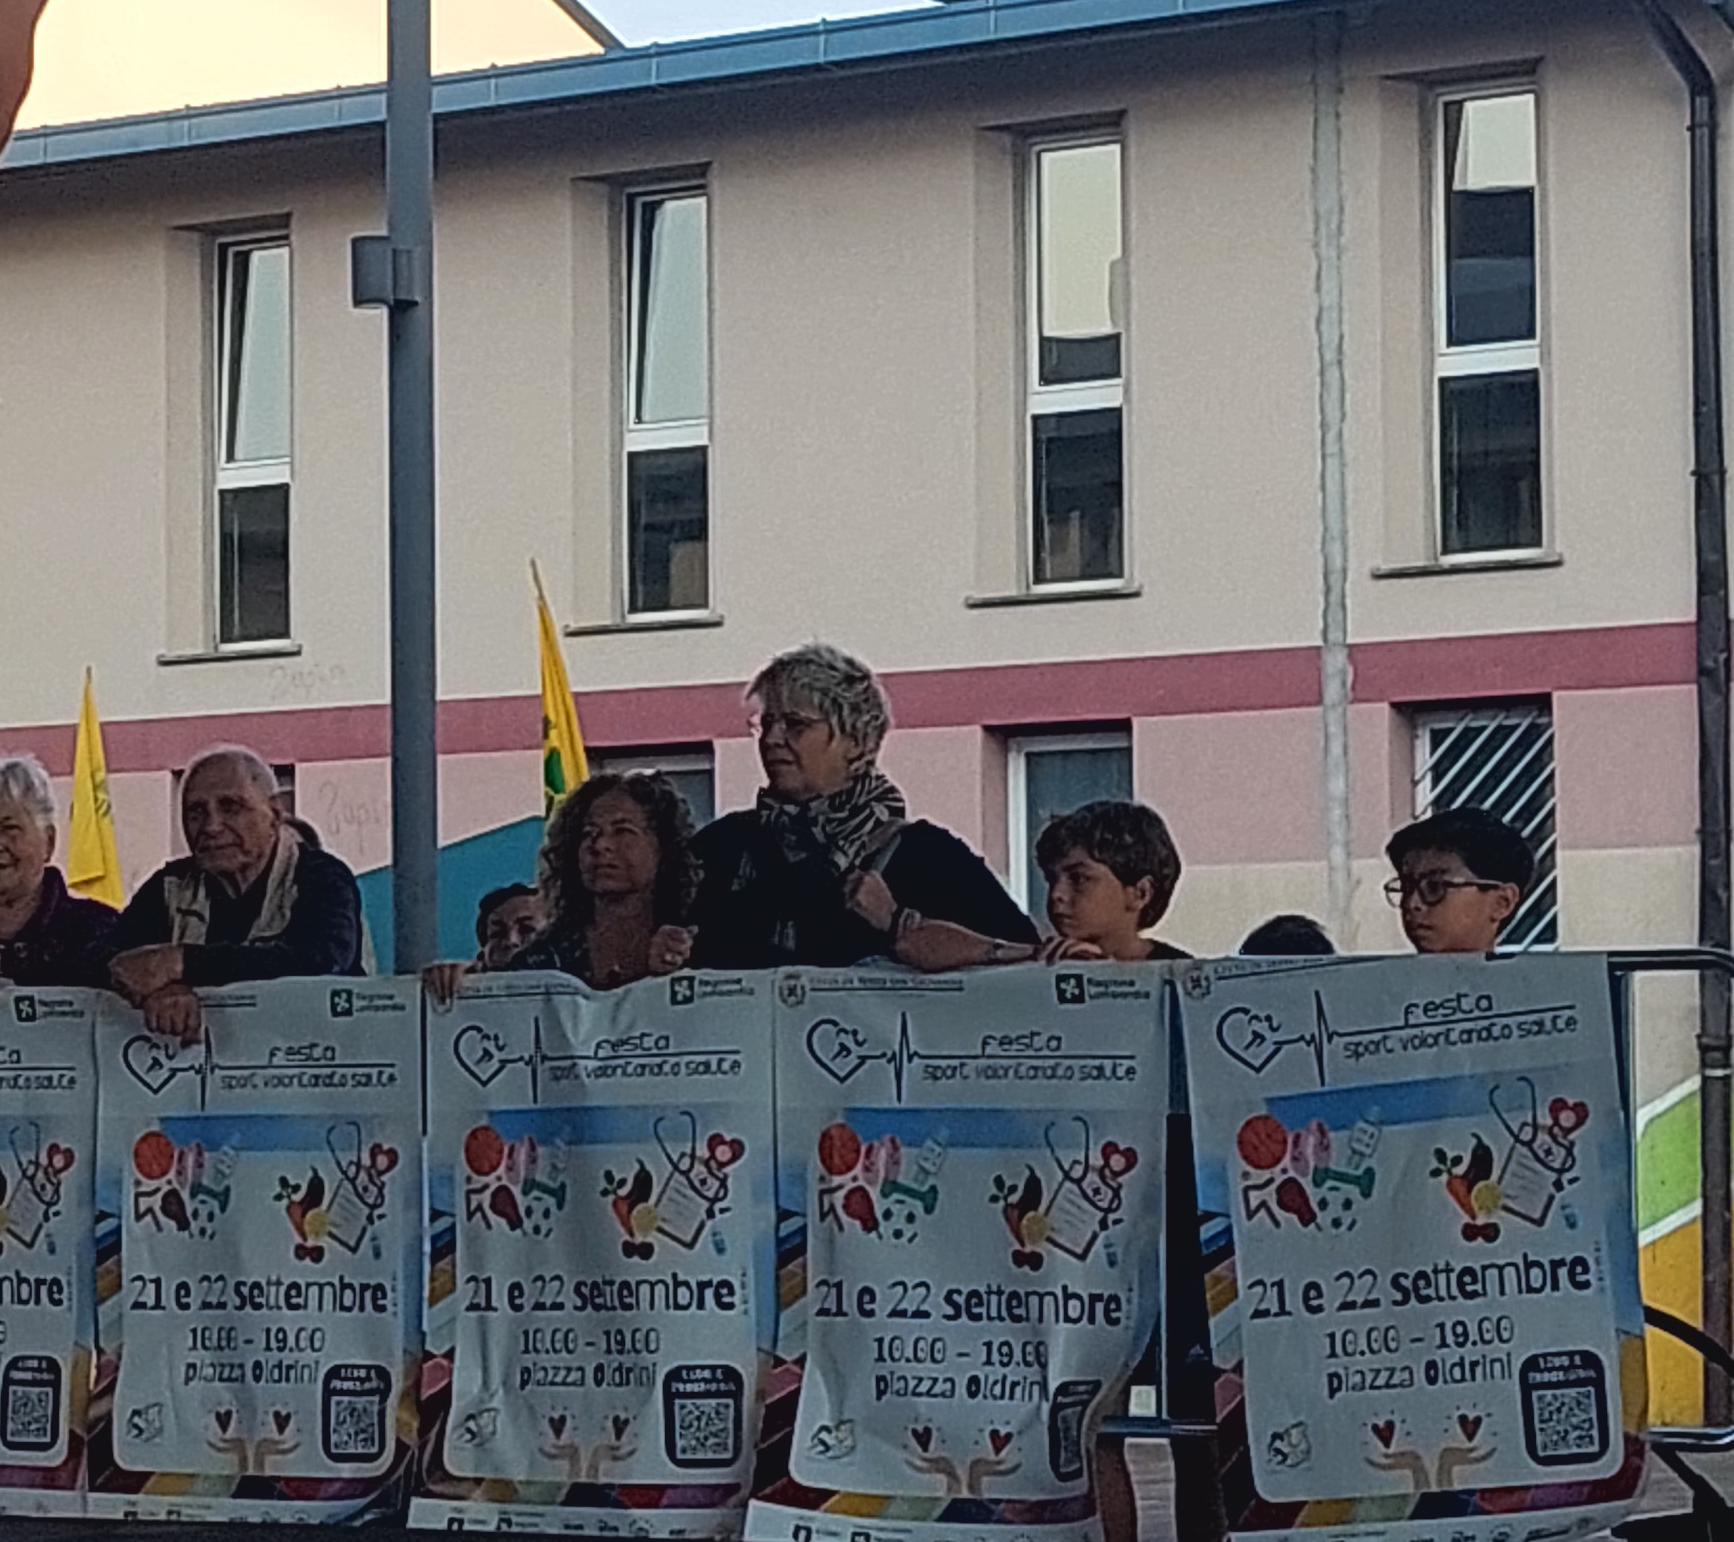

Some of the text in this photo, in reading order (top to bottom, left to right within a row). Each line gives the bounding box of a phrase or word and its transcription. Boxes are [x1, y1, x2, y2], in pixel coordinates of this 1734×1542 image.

[1344, 1038, 1395, 1061] sport
[1517, 1015, 1577, 1040] salute
[130, 1273, 388, 1313] 21 e 22 settembre
[465, 1274, 498, 1312] 21
[508, 1280, 525, 1310] e
[531, 1274, 565, 1311] 22
[573, 1272, 736, 1311] settembre
[815, 1278, 1122, 1326] 21 e 22 settembre
[1247, 1278, 1293, 1320] 21
[1302, 1280, 1326, 1314] e
[1333, 1268, 1382, 1312] 22
[1390, 1252, 1592, 1307] settembre
[982, 1339, 1048, 1369] 19.00
[1325, 1325, 1400, 1359] 10.00
[1434, 1315, 1514, 1350] 19.00
[520, 1362, 585, 1391] piazza
[875, 1372, 956, 1401] piazza
[1327, 1365, 1415, 1400] piazza
[1424, 1352, 1512, 1386] Oldrini
